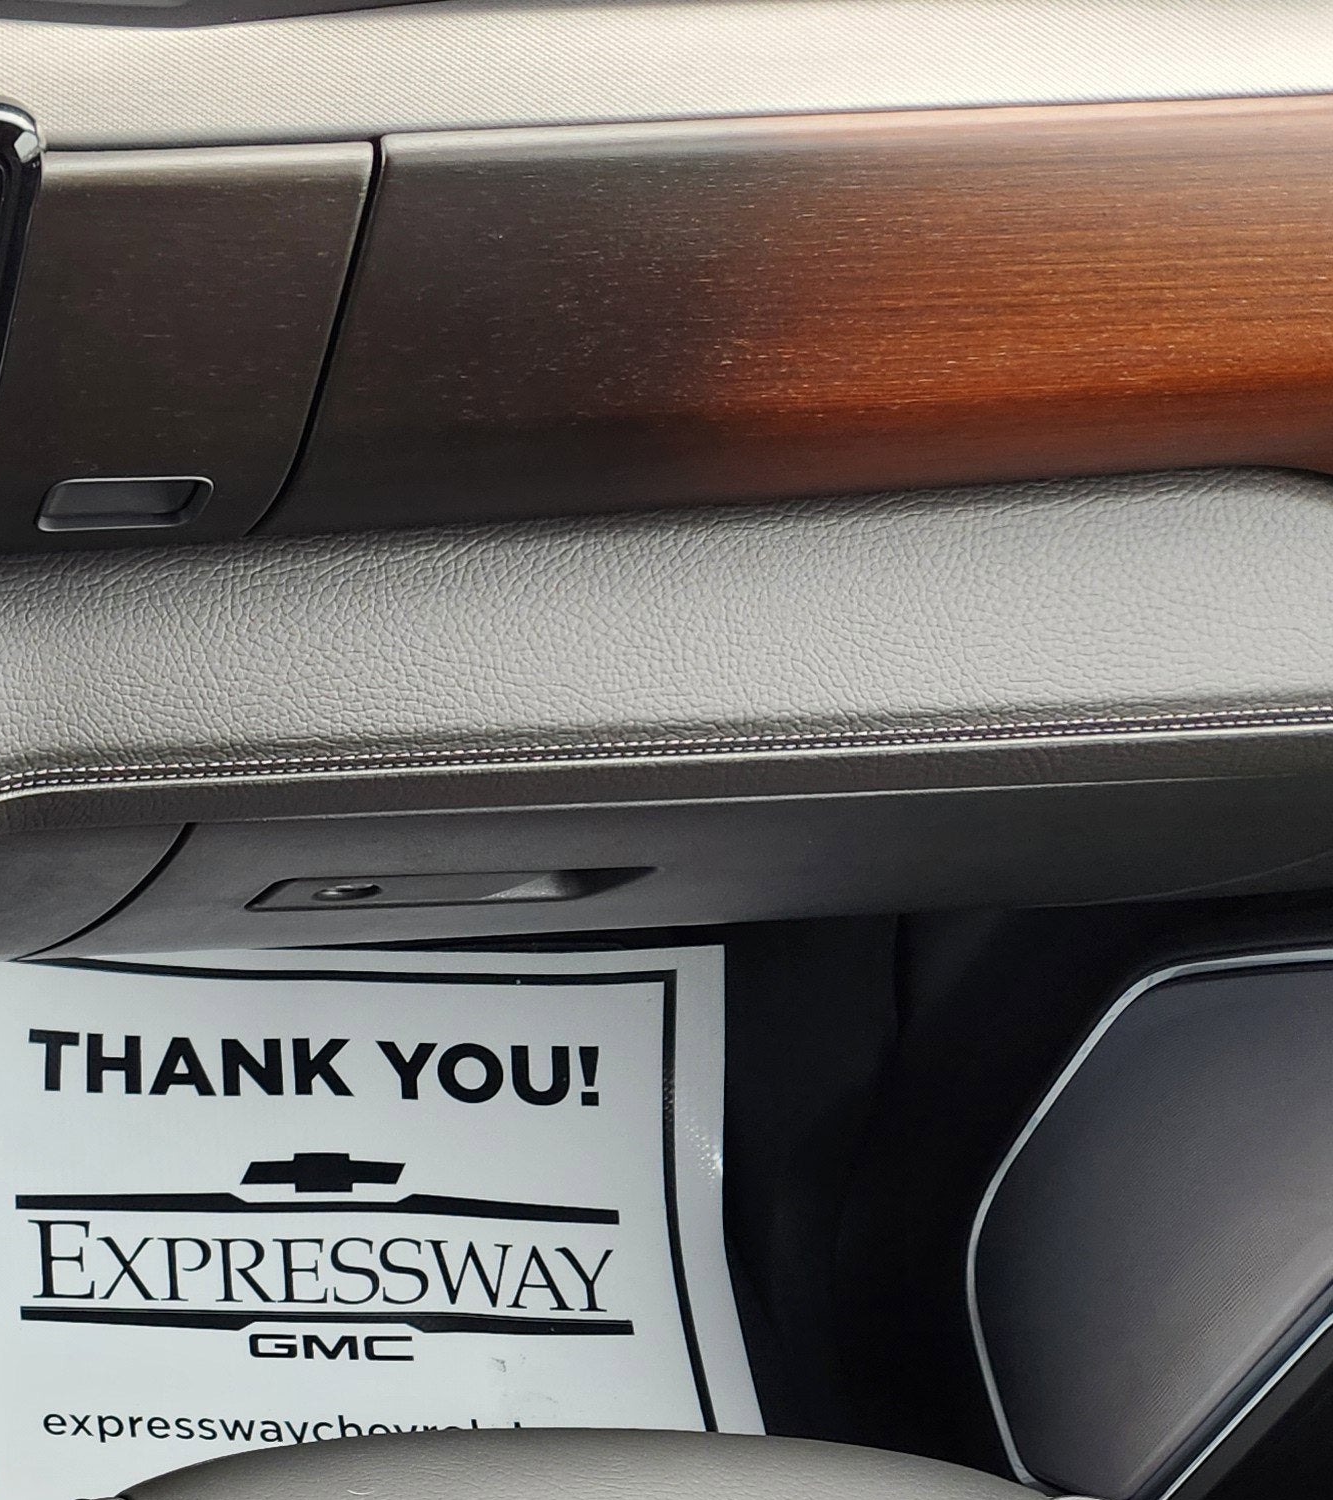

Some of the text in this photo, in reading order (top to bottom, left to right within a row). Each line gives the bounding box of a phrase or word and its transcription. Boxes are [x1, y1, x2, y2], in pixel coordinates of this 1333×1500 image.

[27, 1028, 601, 1108] THANK YOU!
[27, 1218, 616, 1314] EXPRESSWAY
[247, 1332, 416, 1363] GMC
